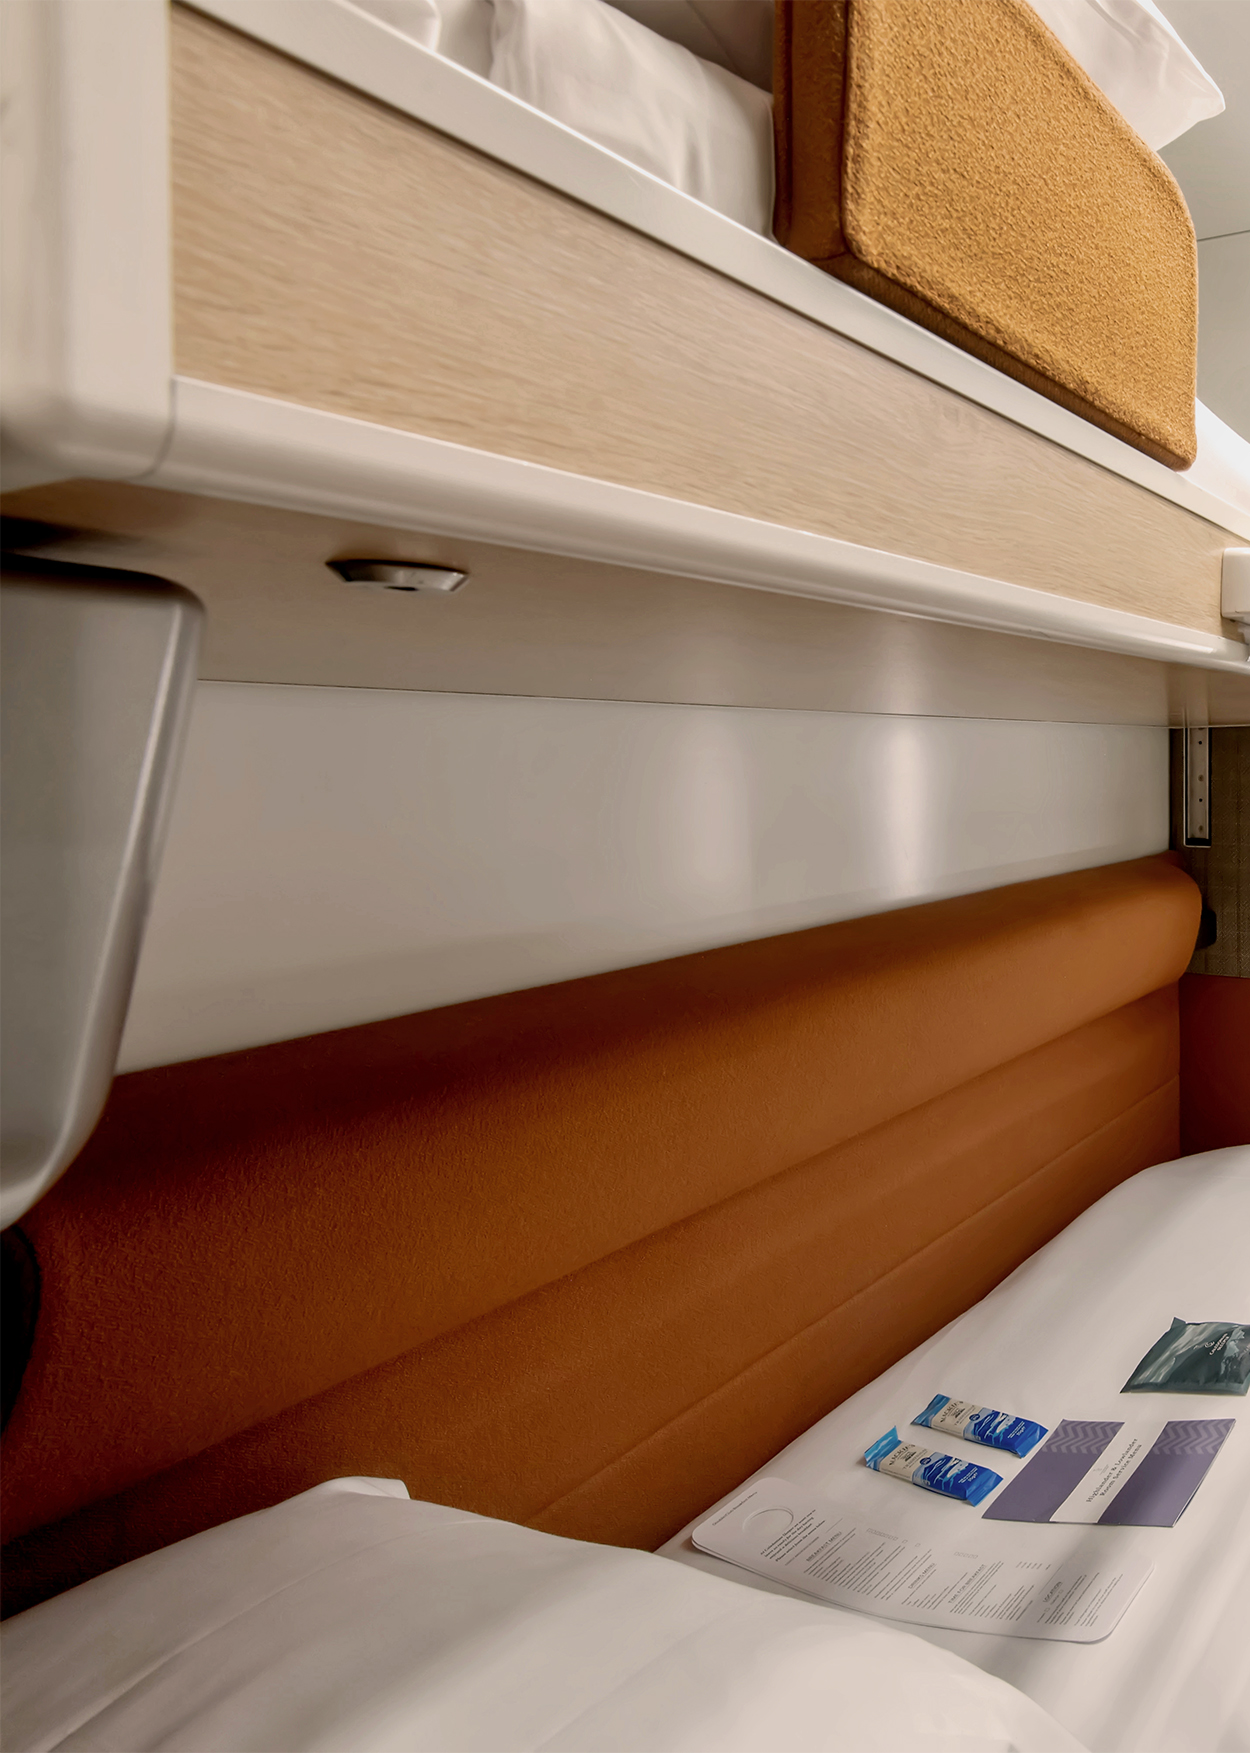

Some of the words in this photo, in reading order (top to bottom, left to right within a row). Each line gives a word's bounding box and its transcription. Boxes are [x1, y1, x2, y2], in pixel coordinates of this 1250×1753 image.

[1086, 1472, 1112, 1502] Highlander
[1115, 1438, 1137, 1465] Lowlander
[1100, 1480, 1115, 1496] Room
[1113, 1460, 1130, 1480] Service
[1128, 1444, 1142, 1460] Menu
[806, 1541, 829, 1561] BREAKFAST
[828, 1531, 842, 1542] MENU
